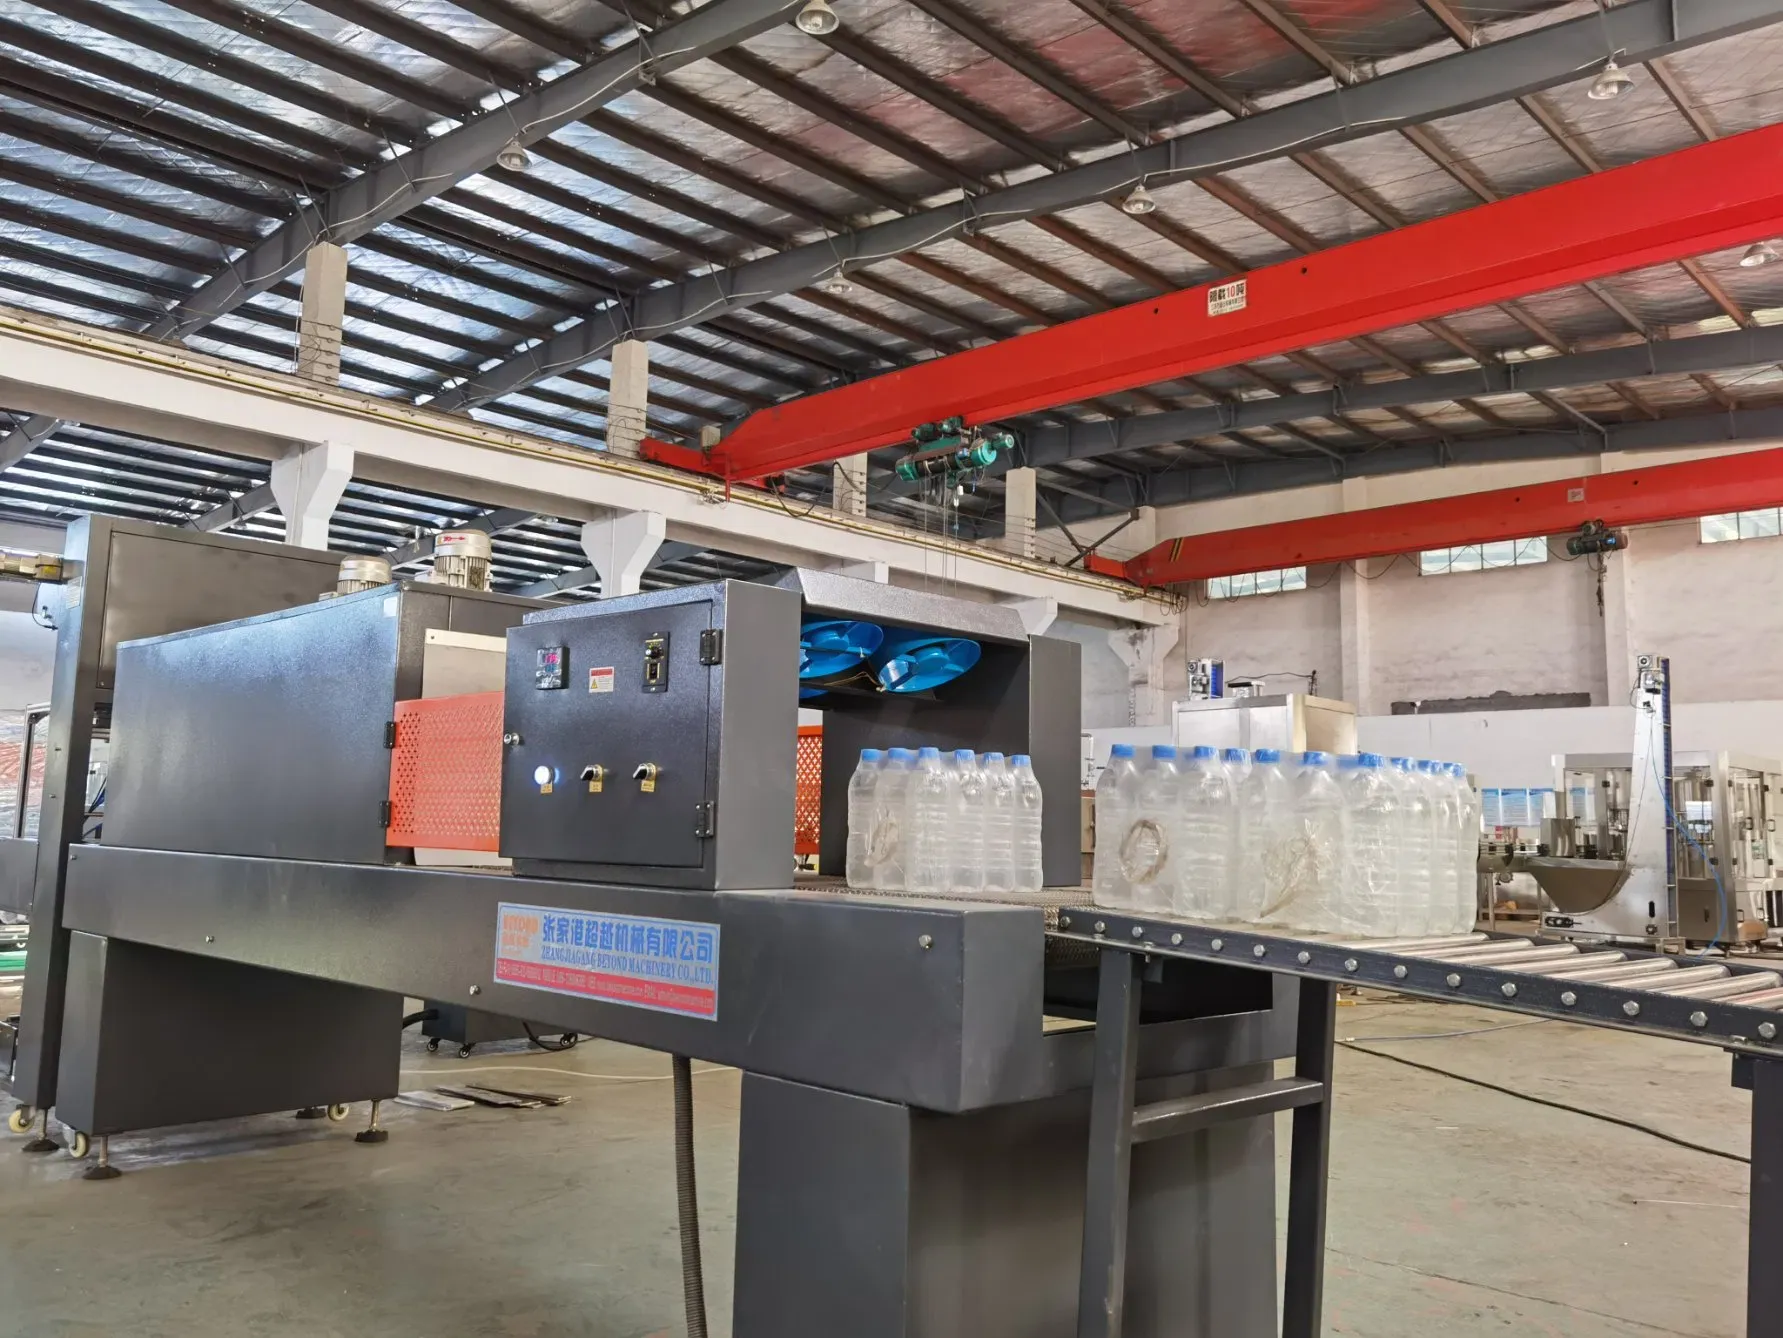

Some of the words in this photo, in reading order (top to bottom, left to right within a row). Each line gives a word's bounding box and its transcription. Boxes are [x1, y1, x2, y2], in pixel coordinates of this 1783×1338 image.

[542, 914, 713, 964] 张家港超越机械有限公司
[541, 945, 596, 965] ZHANGJIAGANG
[597, 952, 628, 972] BEYOND
[628, 957, 676, 978] MACHINERY
